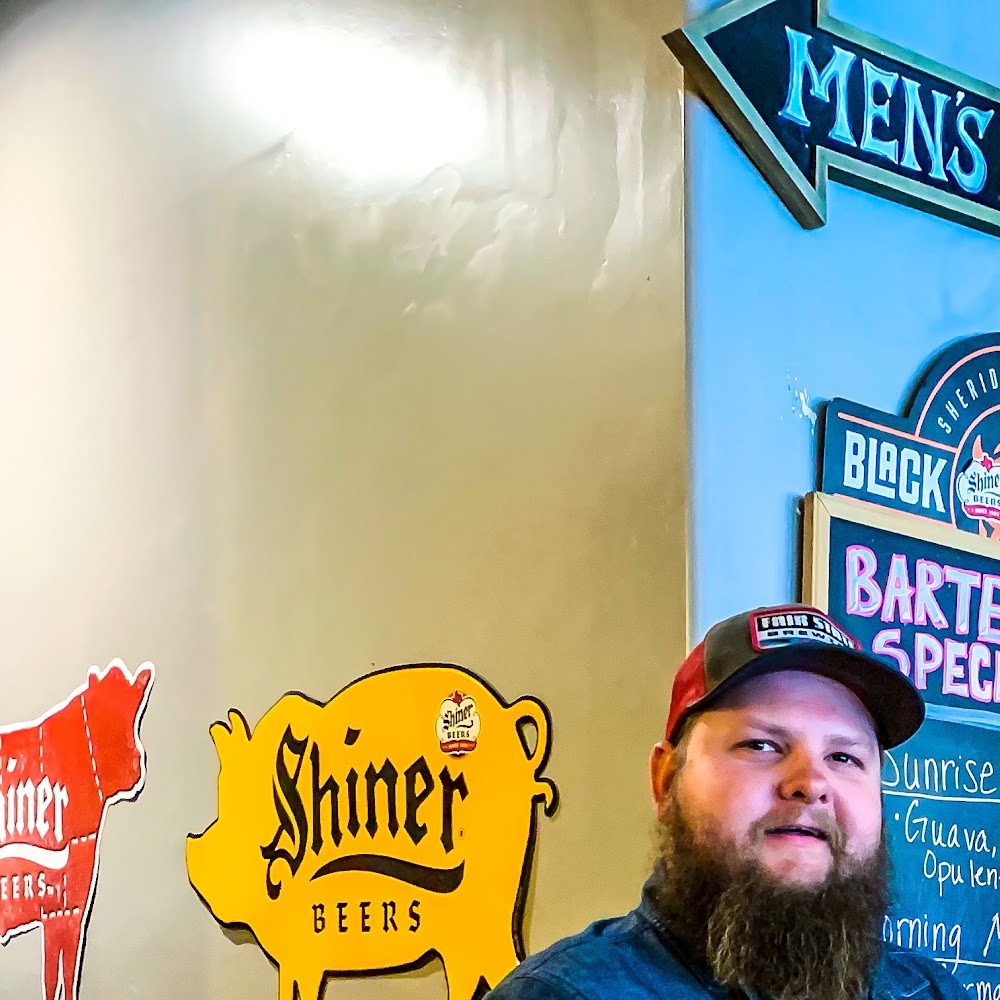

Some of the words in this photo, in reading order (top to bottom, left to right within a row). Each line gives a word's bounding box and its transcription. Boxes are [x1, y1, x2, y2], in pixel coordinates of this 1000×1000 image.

[779, 26, 994, 193] MEN'S
[844, 430, 948, 513] BLACK
[762, 615, 808, 628] FAIR
[442, 704, 473, 730] Shiner
[0, 757, 69, 843] iner
[260, 723, 469, 900] Shiner
[904, 800, 997, 858] Guava,
[0, 872, 46, 900] EERS
[312, 900, 422, 934] BEERS
[883, 913, 961, 974] orning
